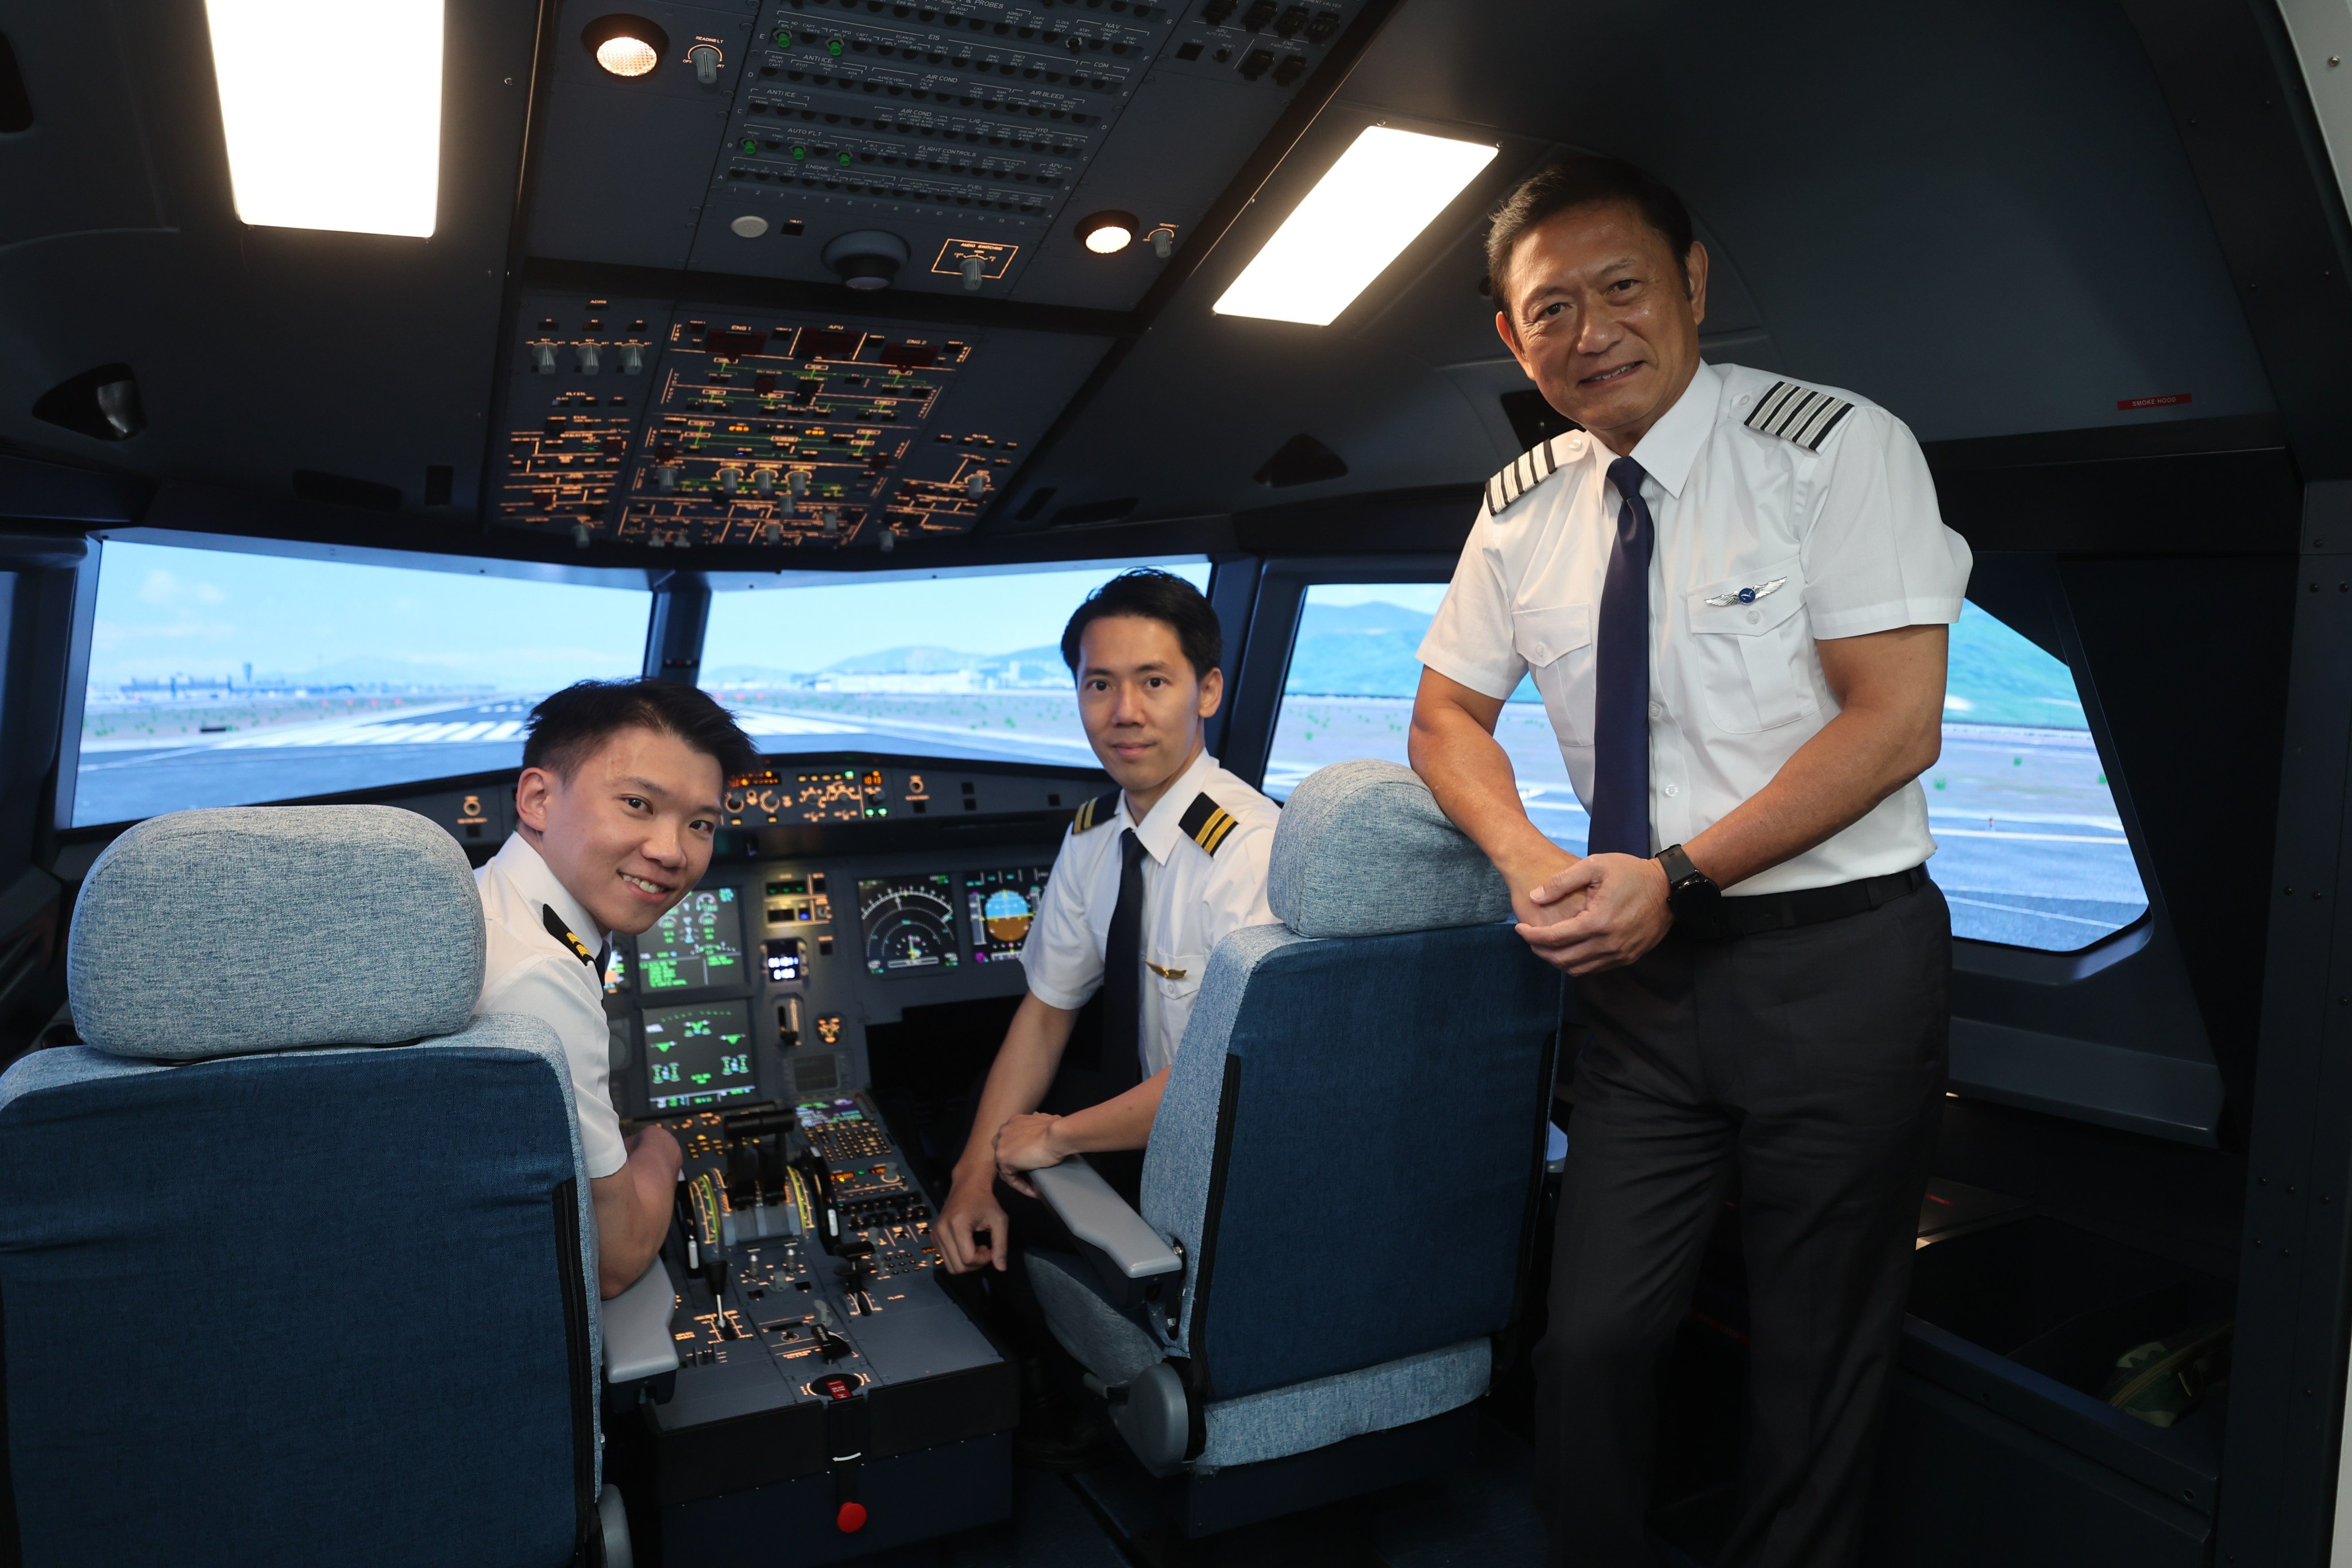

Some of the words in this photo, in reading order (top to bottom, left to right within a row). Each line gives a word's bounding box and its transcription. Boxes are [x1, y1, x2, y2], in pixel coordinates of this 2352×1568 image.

[975, 0, 1004, 9] PROBES
[803, 55, 821, 63] ANTI
[943, 149, 977, 157] CONTROLS
[2132, 399, 2156, 407] SMOKE
